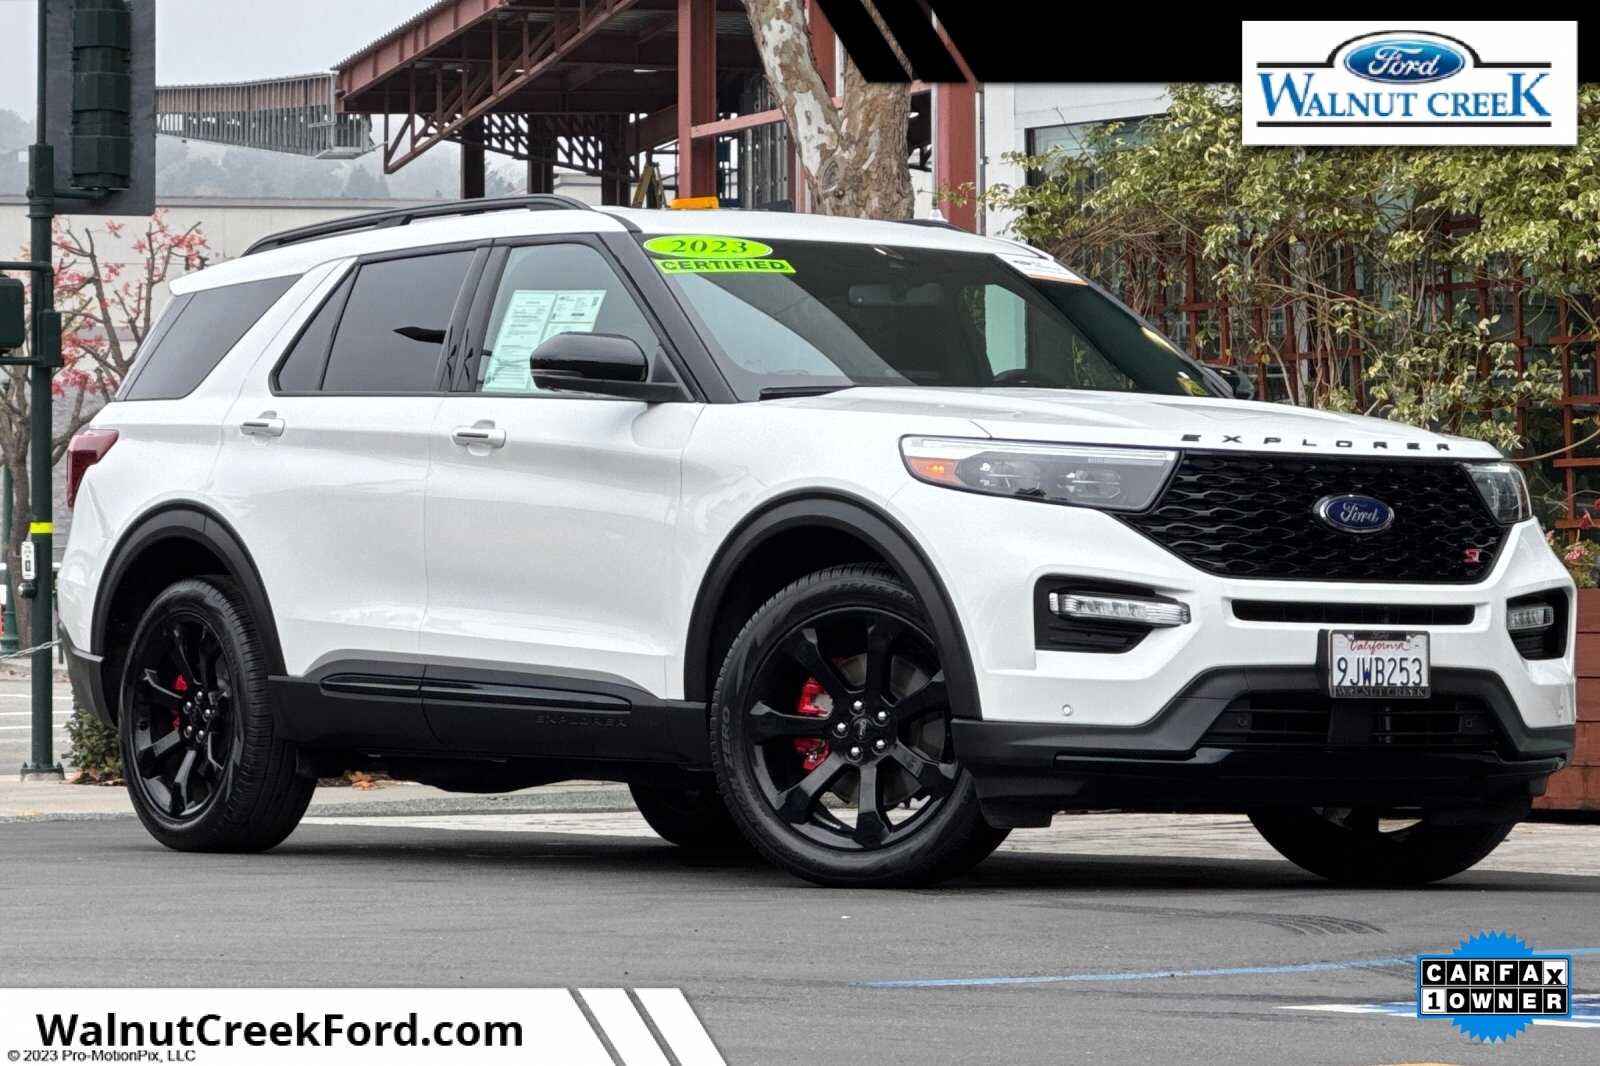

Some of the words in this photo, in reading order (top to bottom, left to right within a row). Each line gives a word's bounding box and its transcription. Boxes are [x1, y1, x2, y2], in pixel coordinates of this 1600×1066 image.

[671, 239, 748, 253] 2023
[1181, 434, 1451, 451] EXPLORER
[1340, 502, 1379, 522] Ford
[1337, 656, 1423, 687] 9JWB253
